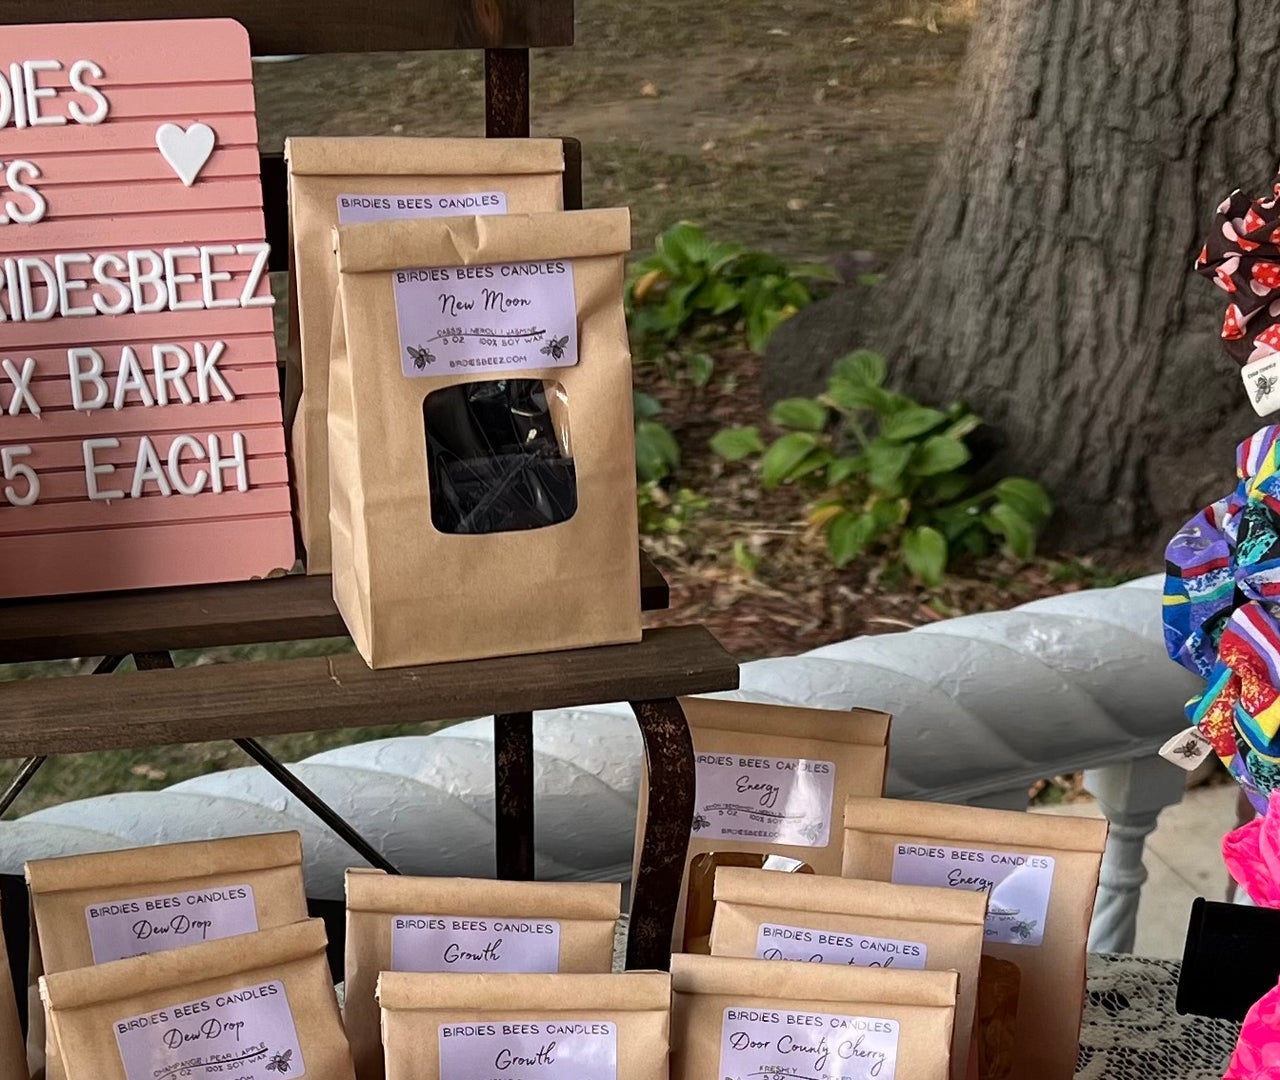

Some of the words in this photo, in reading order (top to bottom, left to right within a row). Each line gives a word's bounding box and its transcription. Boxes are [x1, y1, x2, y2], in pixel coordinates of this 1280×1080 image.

[341, 197, 391, 209] BIRDIES
[398, 198, 432, 209] BEES
[439, 195, 499, 208] CANDLES
[397, 269, 450, 283] BIRDIES
[457, 266, 494, 279] BEES
[501, 262, 566, 277] CANDLES
[438, 294, 474, 317] New
[482, 288, 531, 312] Moon
[67, 340, 235, 413] BARK
[82, 432, 248, 502] EACH
[735, 775, 780, 809] Energy
[898, 845, 945, 859] BIRDIES
[951, 850, 984, 862] BEES
[991, 855, 1049, 869] CANDLES
[947, 869, 994, 892] Energy
[444, 939, 502, 962] Growth
[118, 1012, 168, 1034] BIRDIES
[174, 1001, 211, 1017] BEES
[216, 985, 278, 1007] CANDLES
[728, 1011, 780, 1024] BIRDIES
[787, 1015, 823, 1027] BEES
[830, 1019, 892, 1034] CANDLES
[443, 1026, 496, 1037] BIRDIES
[503, 1025, 539, 1034] BEES
[547, 1024, 609, 1035] CANDLES
[495, 1042, 556, 1070] Growth
[730, 1032, 770, 1050] Door
[777, 1035, 830, 1071] County
[837, 1035, 886, 1077] Cherry
